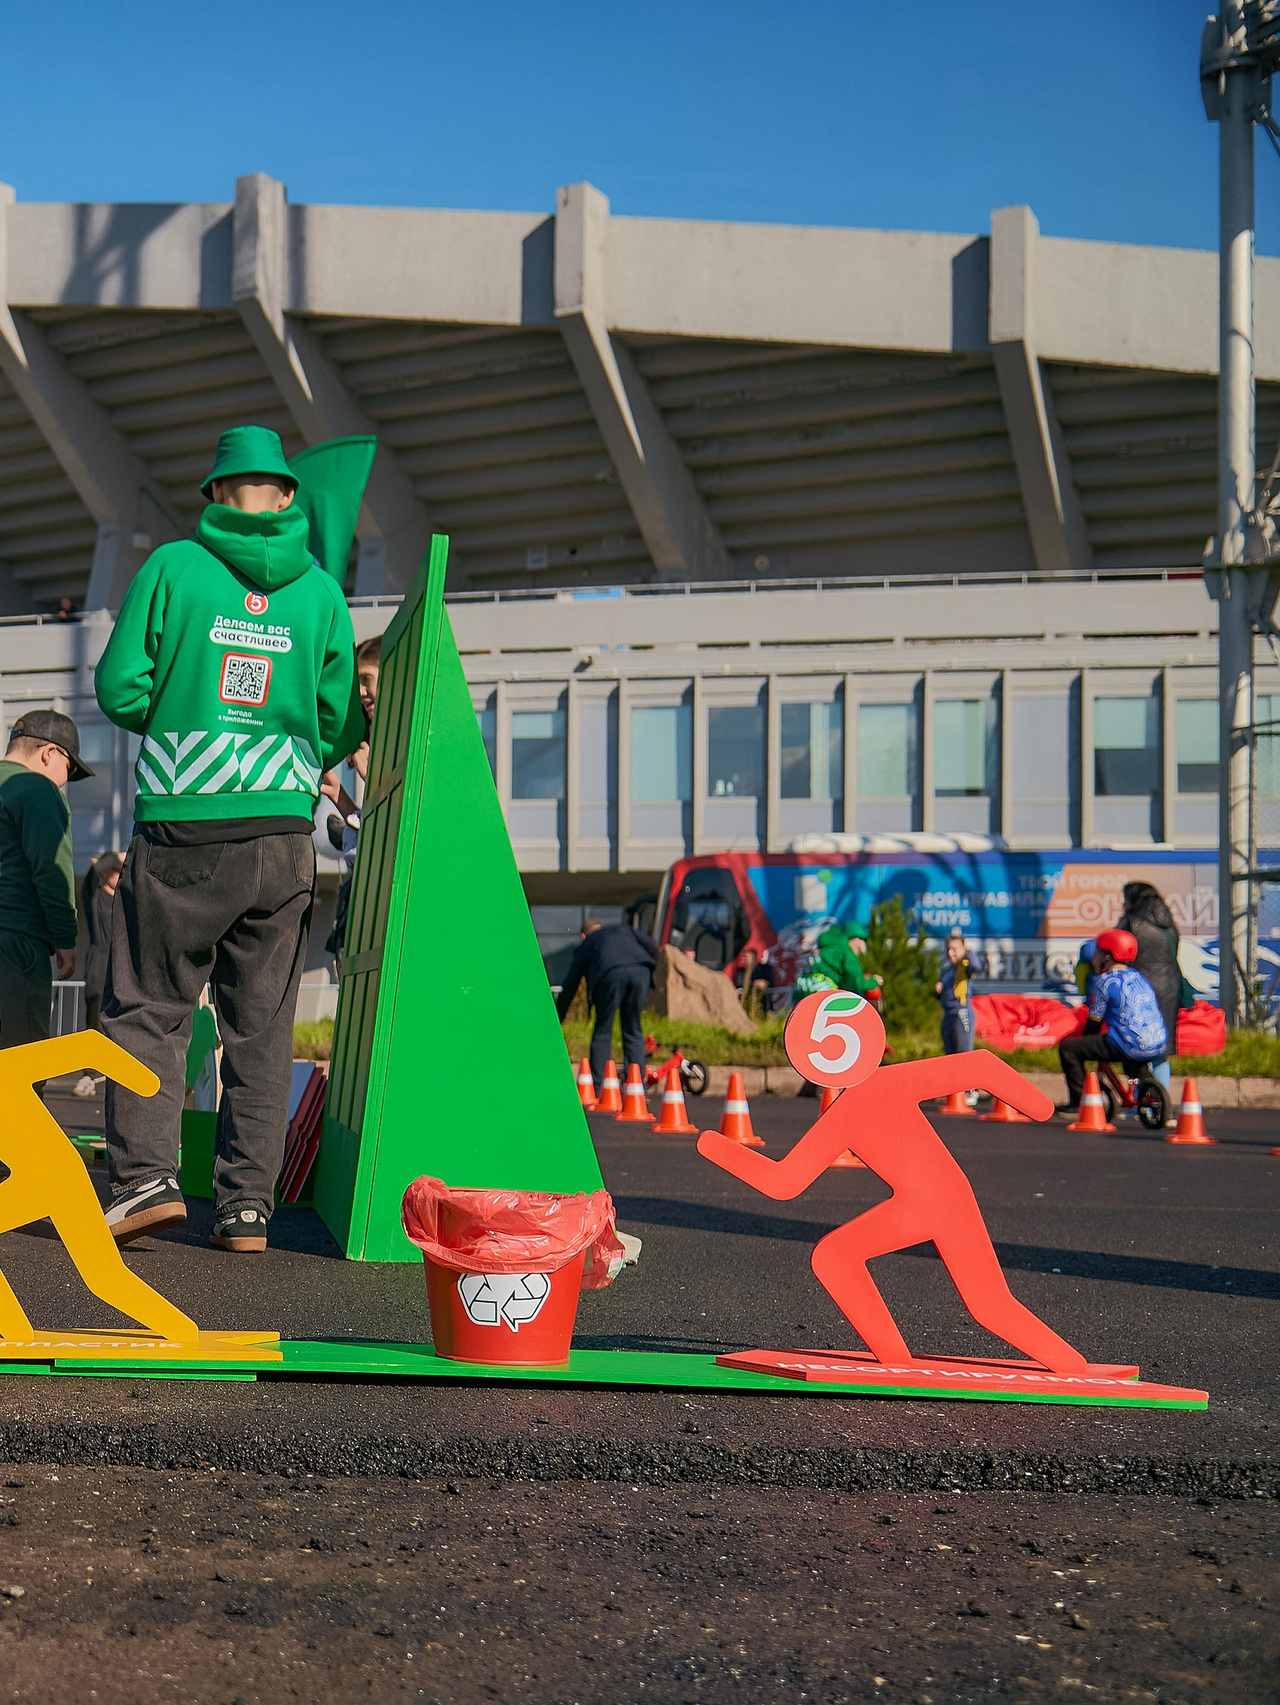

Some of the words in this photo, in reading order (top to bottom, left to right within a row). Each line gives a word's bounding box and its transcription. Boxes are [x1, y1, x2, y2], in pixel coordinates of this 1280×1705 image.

[250, 592, 265, 610] 5
[214, 615, 265, 633] Делаем
[267, 625, 291, 636] вас
[214, 630, 288, 648] счастливее
[227, 708, 253, 718] Выгода
[922, 910, 971, 926] КЛУБ
[807, 991, 868, 1074] 5
[775, 1362, 1143, 1386] НЕСОРТИРУЕМОЕ
